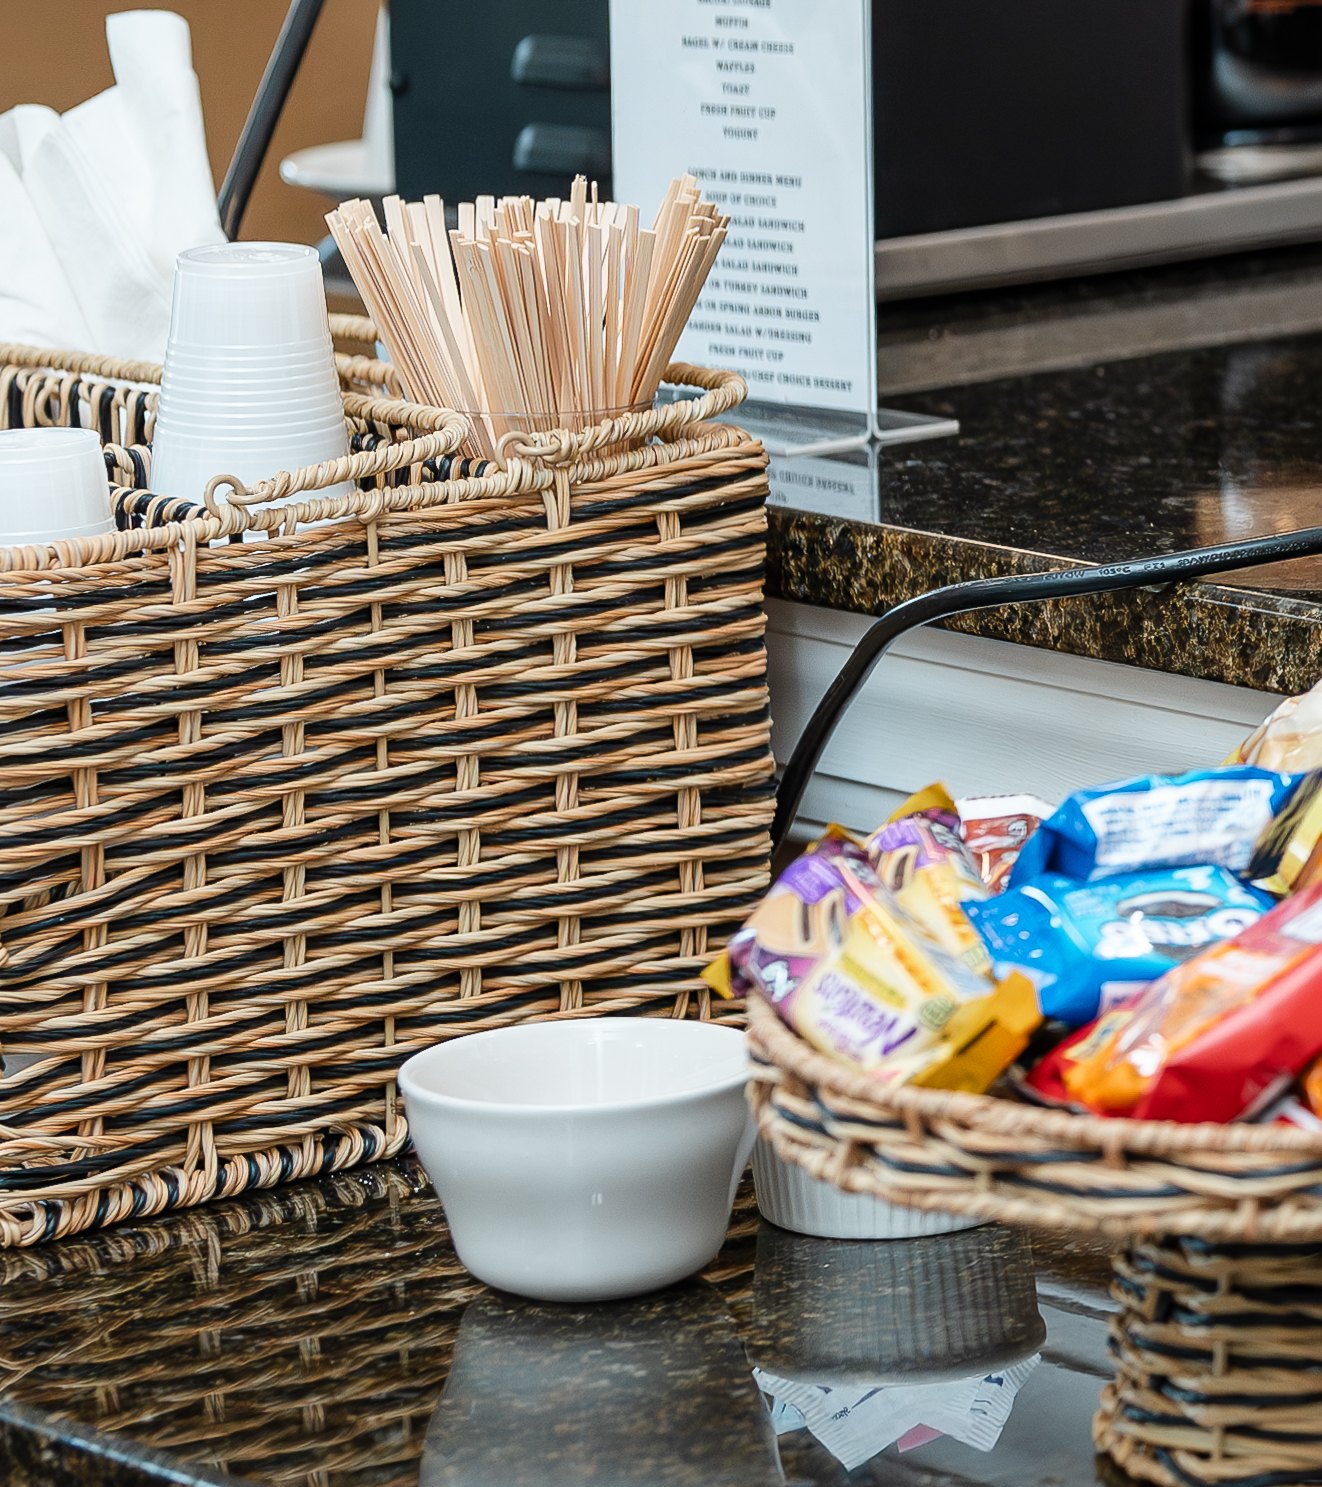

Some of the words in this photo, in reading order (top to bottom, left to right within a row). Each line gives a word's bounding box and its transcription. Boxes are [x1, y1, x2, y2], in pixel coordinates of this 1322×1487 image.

[715, 15, 748, 28] MUFFIN
[682, 36, 708, 49] BAGEL
[728, 38, 758, 53] CREAM
[761, 40, 795, 54] CHEESE
[716, 60, 756, 74] WAFFLES
[722, 82, 751, 96] TOAST
[700, 102, 727, 116] FRESH
[730, 105, 756, 118] FRUIT
[758, 106, 776, 120] CUP
[723, 126, 758, 141] YOGURT
[720, 170, 738, 182] AND
[740, 172, 773, 186] DINNER
[776, 174, 803, 188] MENU
[705, 191, 727, 203] SOUP
[730, 192, 742, 204] OF
[744, 193, 777, 208] CHOICE
[758, 217, 805, 232] SANDWICH
[747, 238, 794, 254] SANDWICH
[722, 258, 748, 270] SALAD
[752, 260, 799, 276] SANDWICH
[724, 280, 758, 294] TURKEY
[761, 283, 808, 300] SANDWICH
[720, 302, 750, 316] SPRING
[753, 305, 782, 318] ARBOR
[785, 308, 820, 322] BURGER
[725, 324, 752, 338] SALAD
[708, 344, 736, 356] FRESH
[738, 345, 766, 360] FRUIT
[766, 348, 784, 362] CUP
[778, 373, 812, 388] CHOICE
[814, 376, 853, 392] DESSERT
